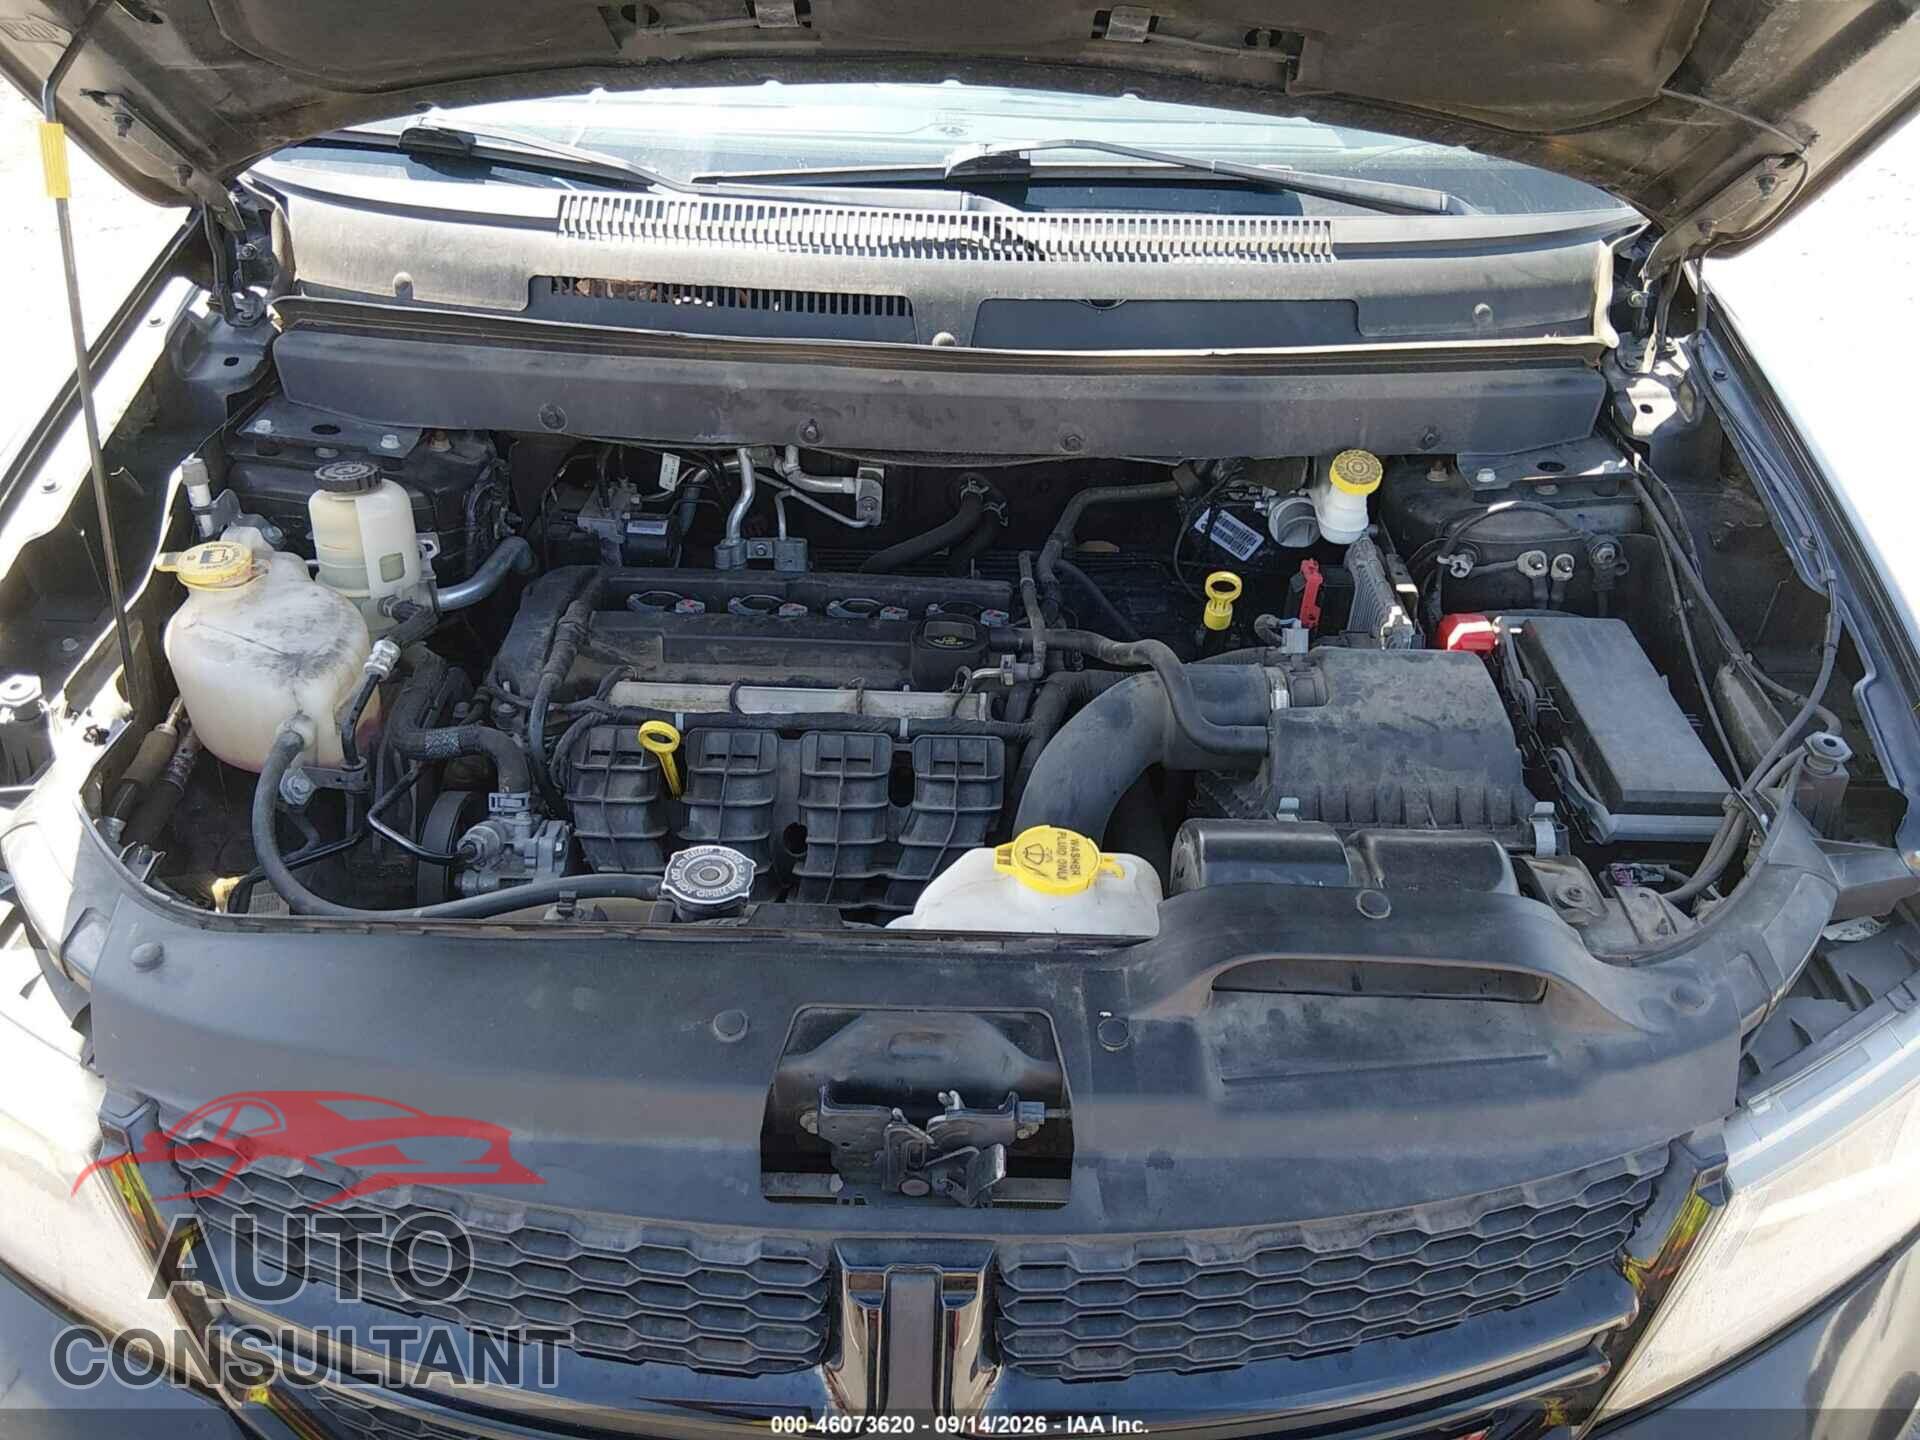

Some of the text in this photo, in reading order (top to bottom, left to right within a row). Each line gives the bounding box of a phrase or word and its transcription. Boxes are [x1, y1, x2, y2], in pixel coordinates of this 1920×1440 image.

[1056, 831, 1067, 881] FLUID ONLY
[1070, 838, 1081, 876] WASHER
